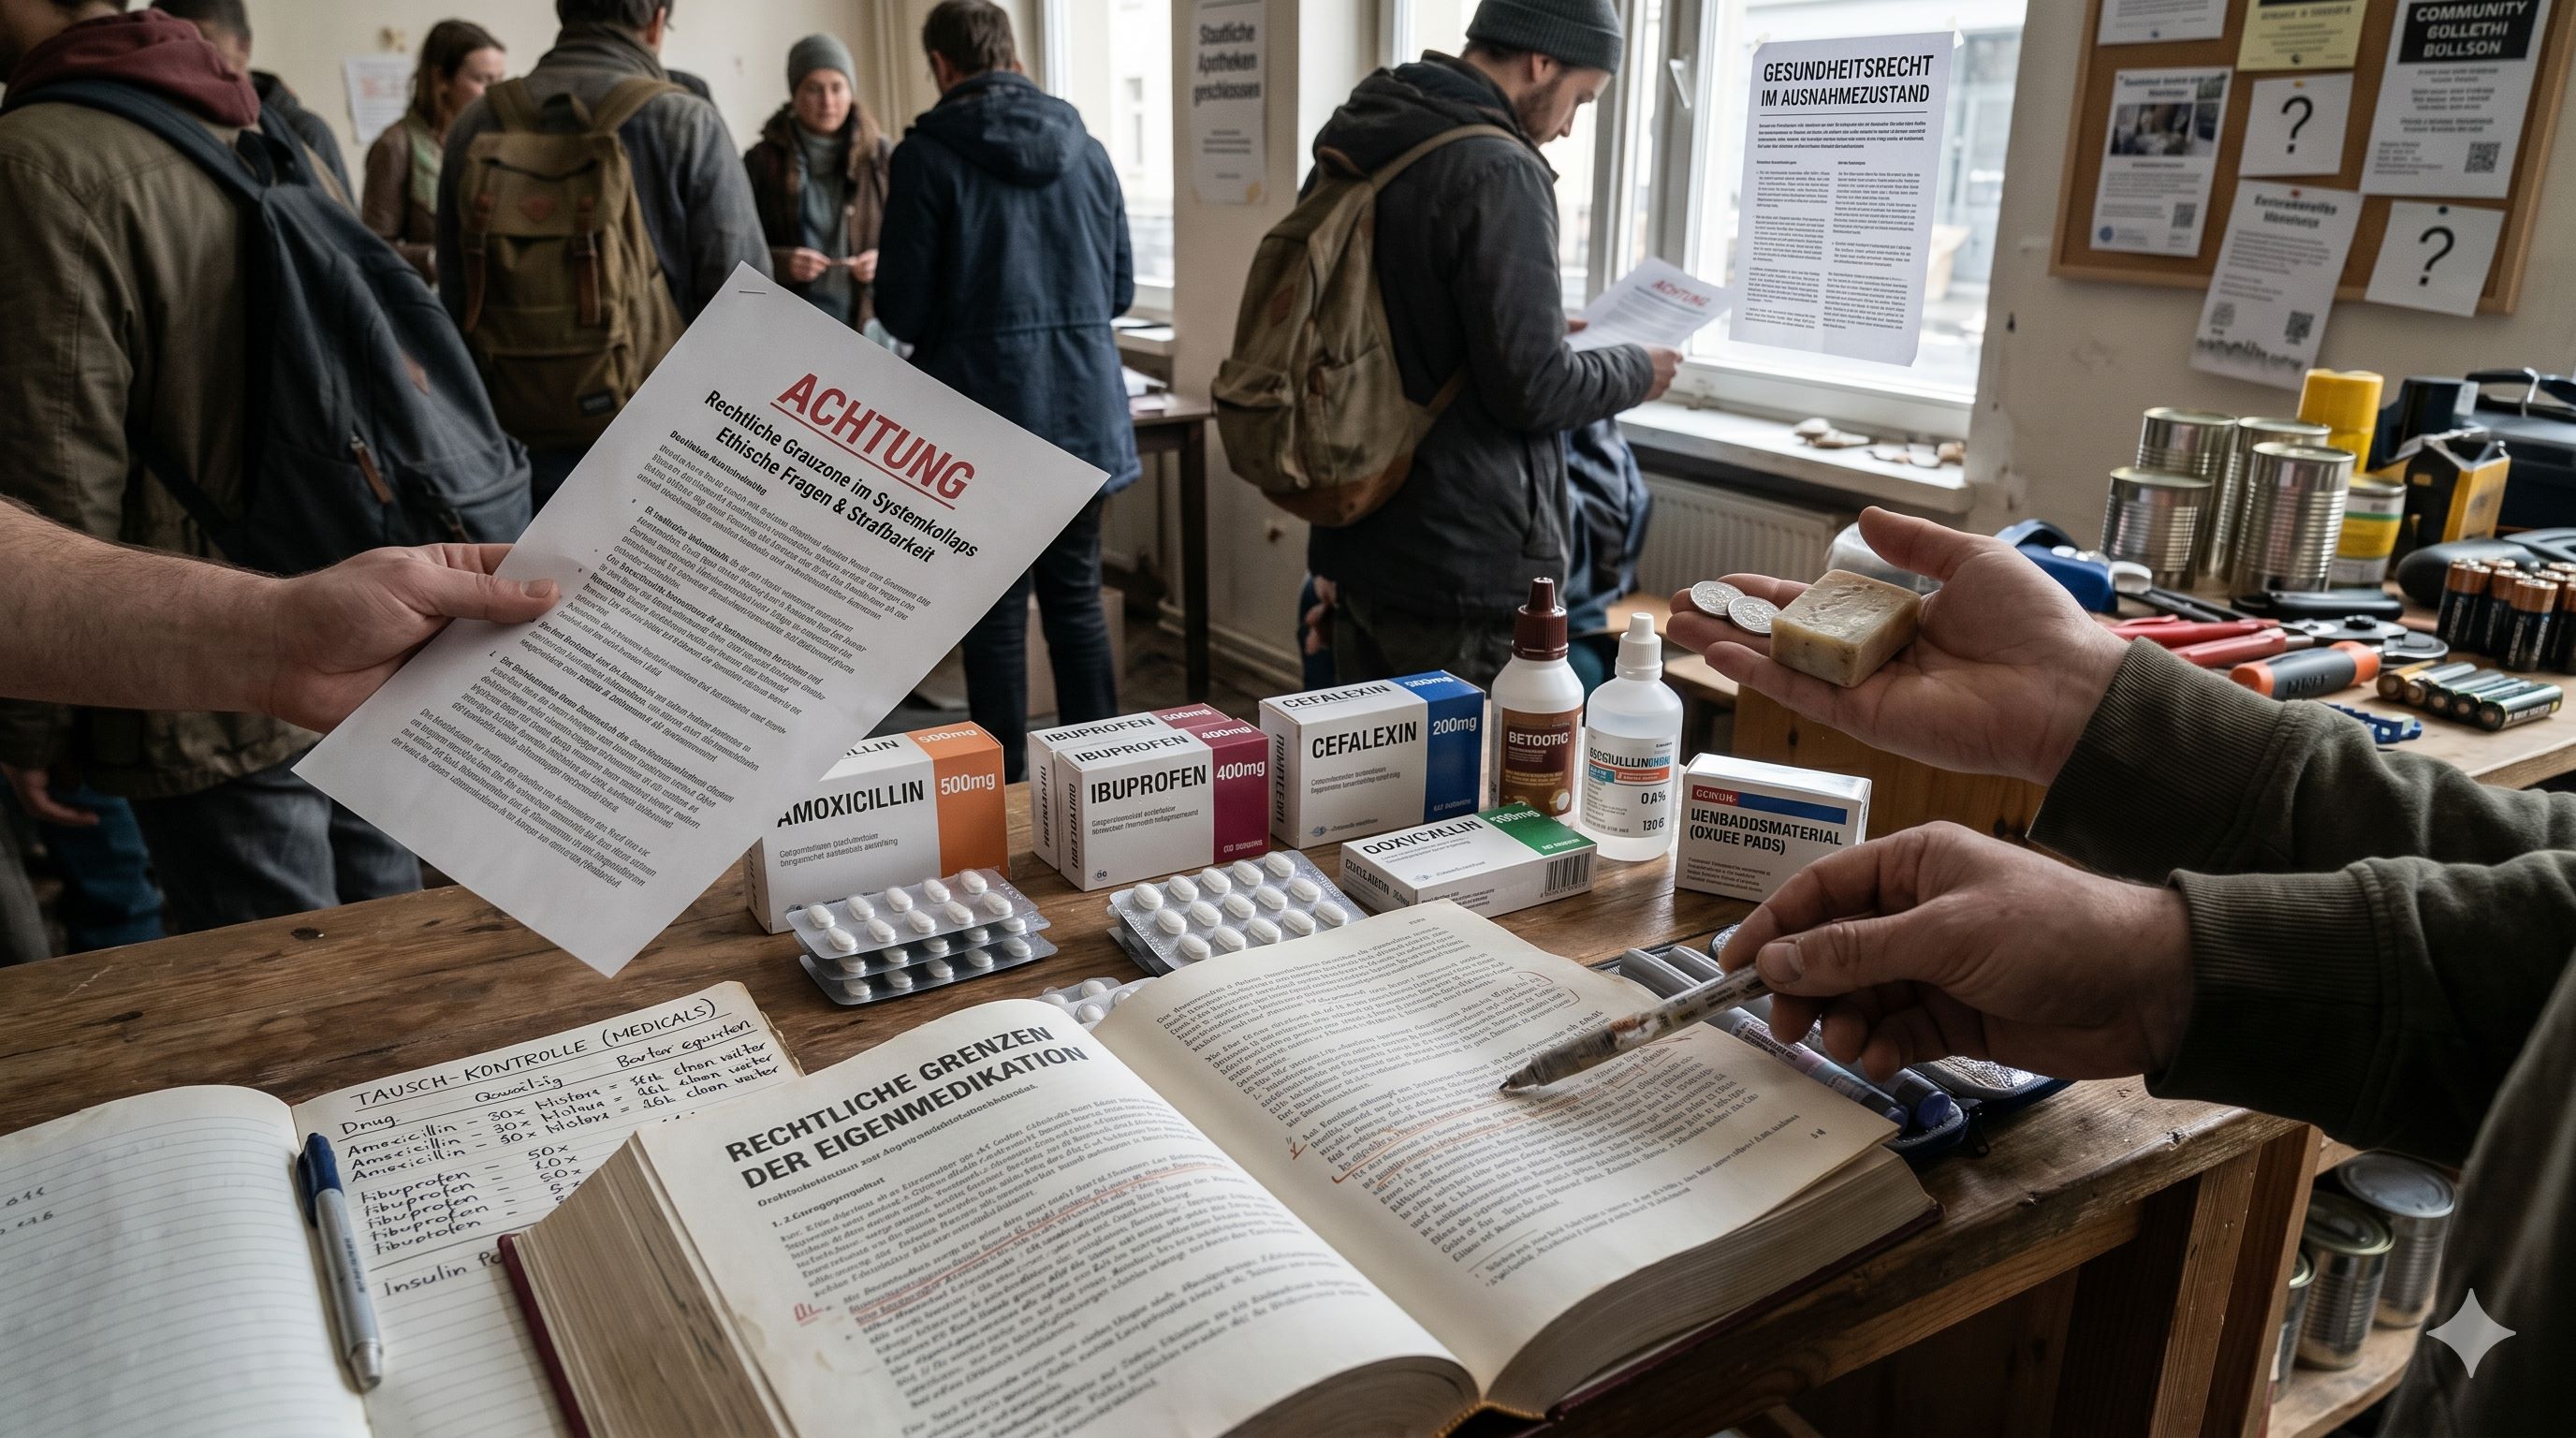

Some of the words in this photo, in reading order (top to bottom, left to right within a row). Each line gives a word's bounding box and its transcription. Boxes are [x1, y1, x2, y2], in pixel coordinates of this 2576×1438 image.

[2416, 2, 2527, 22] COMMUNITY
[1764, 54, 1934, 81] GESUNDHEITSRECHT
[1761, 90, 1777, 106] IM
[1781, 84, 1929, 106] AUSNAHMEZUSTAND
[2281, 95, 2313, 154] ?
[2419, 226, 2454, 286] ?
[777, 374, 974, 499] ACHTUNG
[705, 390, 782, 446] Rechtliche
[783, 439, 850, 487] Grauzone
[851, 478, 871, 500] im
[873, 492, 977, 556] Systemkollaps
[716, 427, 780, 474] Ethische
[780, 466, 832, 506] Fragen
[833, 498, 847, 515] &
[847, 506, 935, 562] Strafbarkeit
[1282, 684, 1391, 709] CEFALEXIN
[1045, 717, 1156, 742] IBUPROFEN
[1311, 721, 1417, 758] CEFALEXIN
[1433, 716, 1477, 735] 200mg
[1075, 735, 1190, 763] IBUPROFEN
[941, 772, 995, 795] 500mg
[1090, 764, 1207, 804] IBUPROFEN
[1217, 761, 1266, 780] 400mg
[777, 779, 924, 828] AMOXICILLIN
[1690, 824, 1740, 844] (OXUEE
[1744, 833, 1786, 855] PADS)
[350, 1039, 588, 1106] TAUSCH-KONTROLLE
[602, 998, 715, 1047] (MEDICALS)
[724, 1073, 917, 1163] RECHTLICHE
[918, 1026, 1054, 1081] GRENZEN
[740, 1151, 812, 1189] DER
[813, 1046, 1090, 1162] EIGENMEDIKATION
[385, 1265, 466, 1296] Insulin
